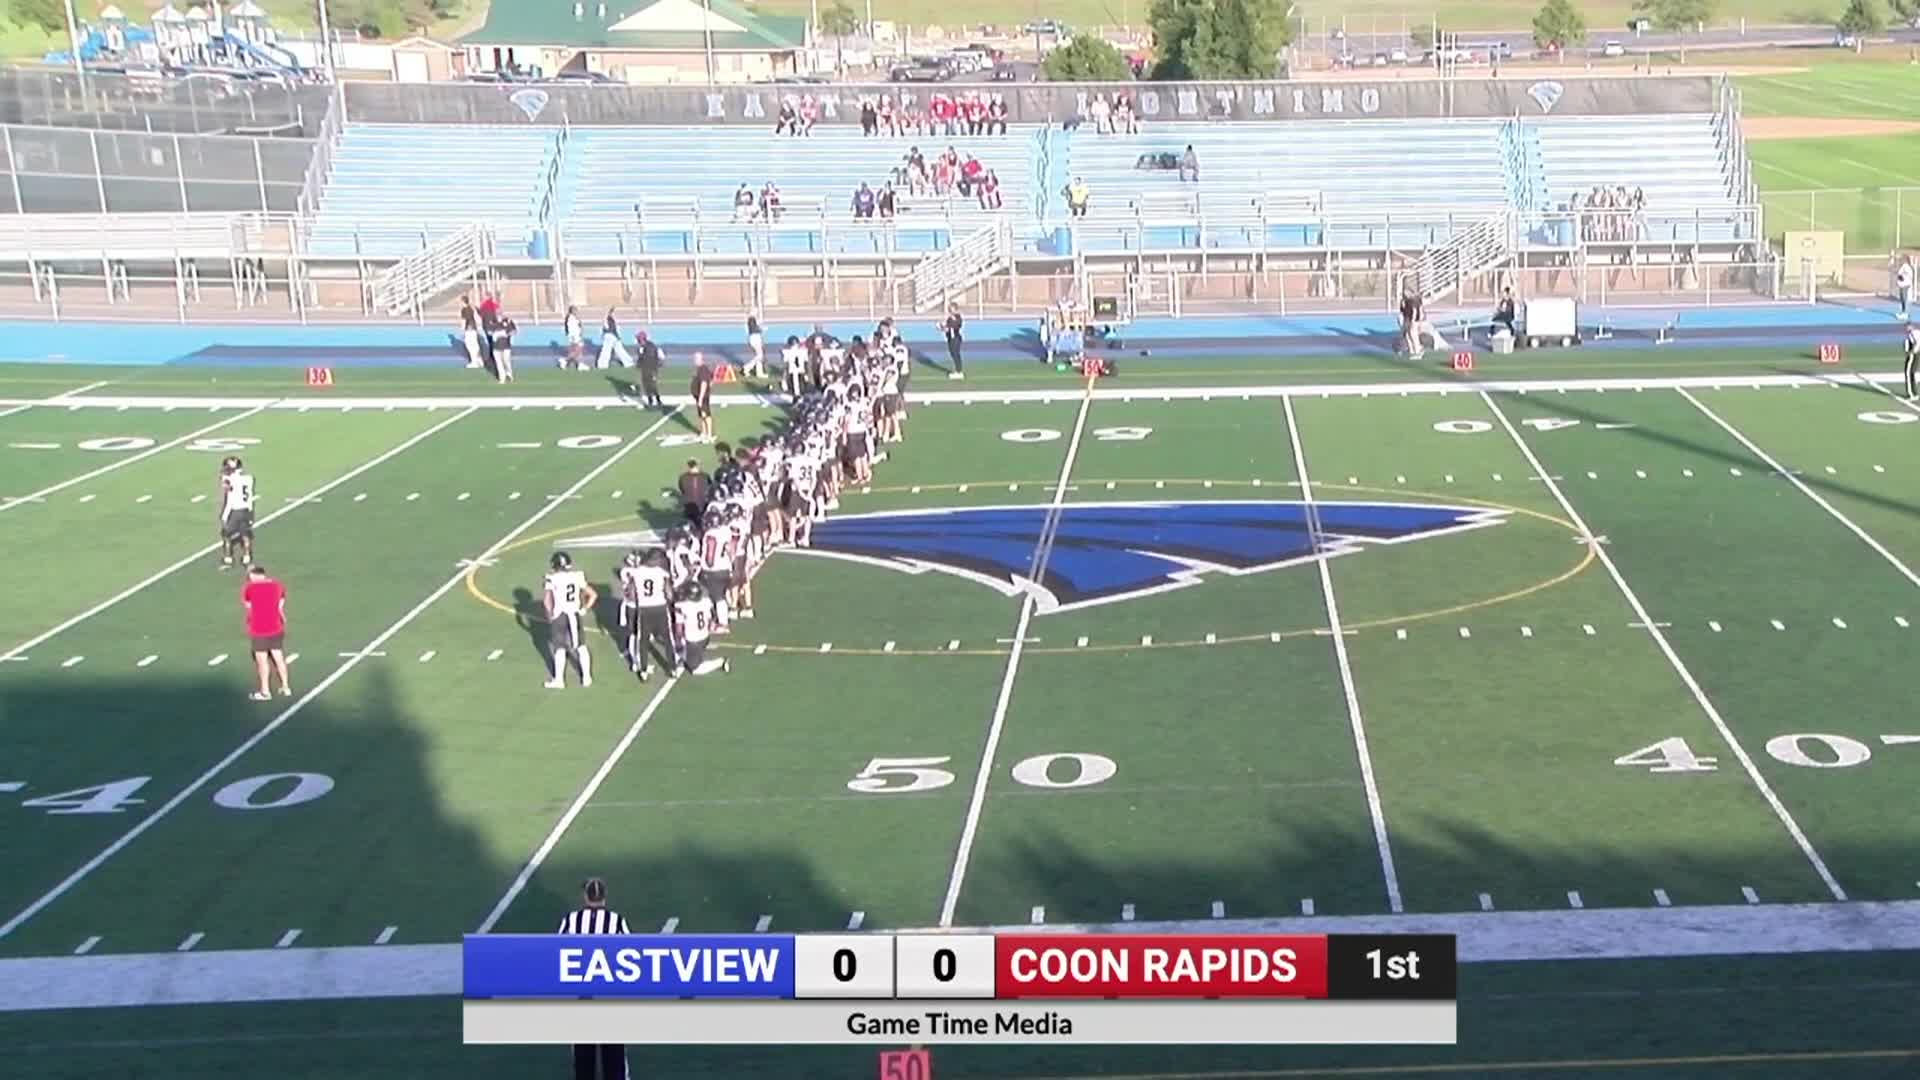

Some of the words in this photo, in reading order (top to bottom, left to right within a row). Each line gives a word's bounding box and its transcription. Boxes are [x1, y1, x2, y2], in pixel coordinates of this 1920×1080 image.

[1455, 352, 1471, 368] 40
[1821, 344, 1838, 361] 30
[242, 484, 250, 502] 5
[565, 583, 576, 602] 2
[643, 578, 654, 597] 9
[696, 610, 706, 630] 8
[887, 1053, 923, 1080] 50
